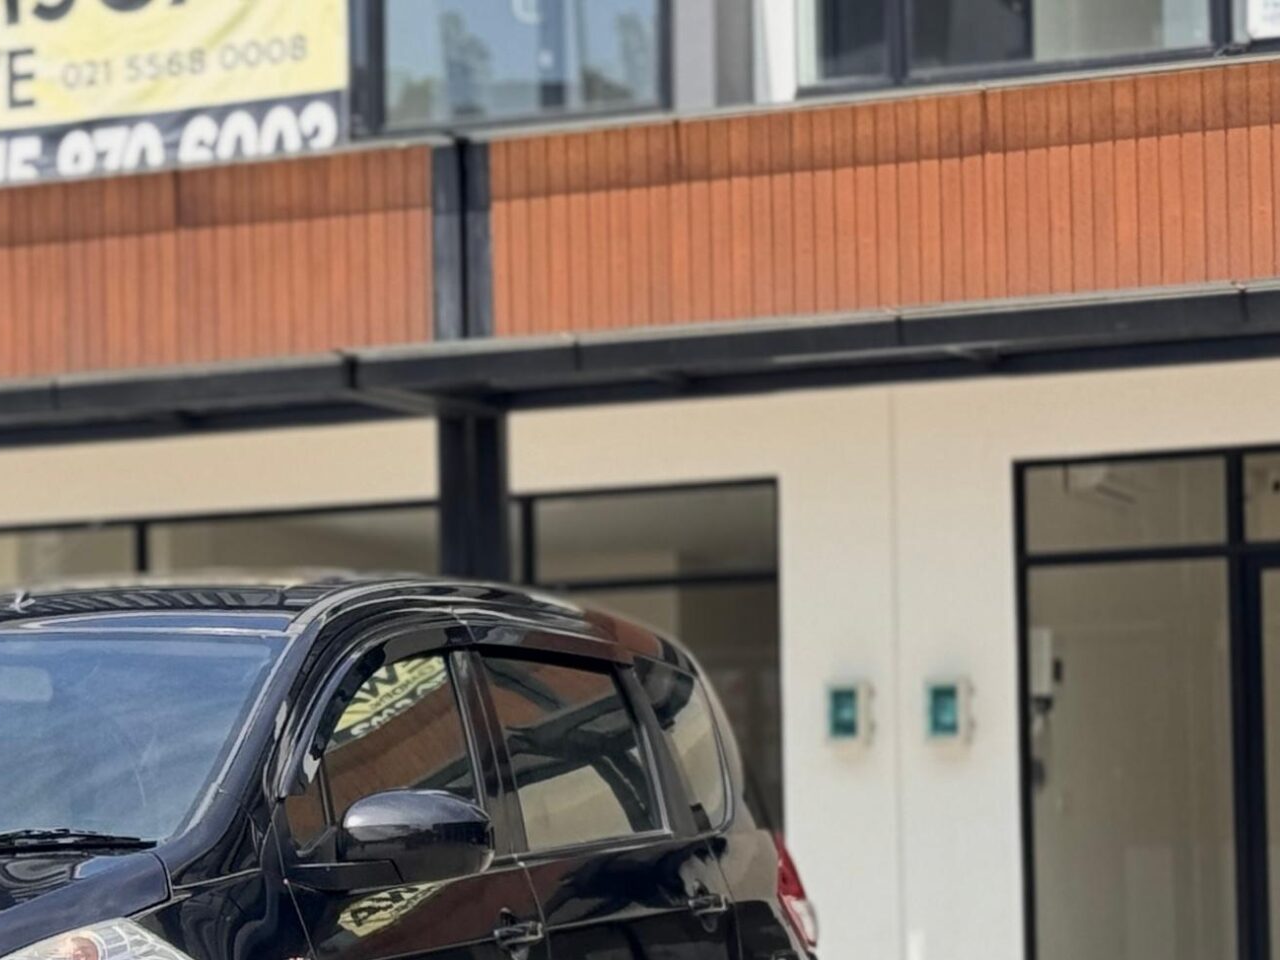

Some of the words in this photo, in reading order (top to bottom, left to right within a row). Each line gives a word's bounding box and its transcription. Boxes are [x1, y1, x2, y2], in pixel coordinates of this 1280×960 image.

[62, 58, 113, 89] 021
[125, 46, 208, 82] 5568
[220, 34, 308, 70] 0008
